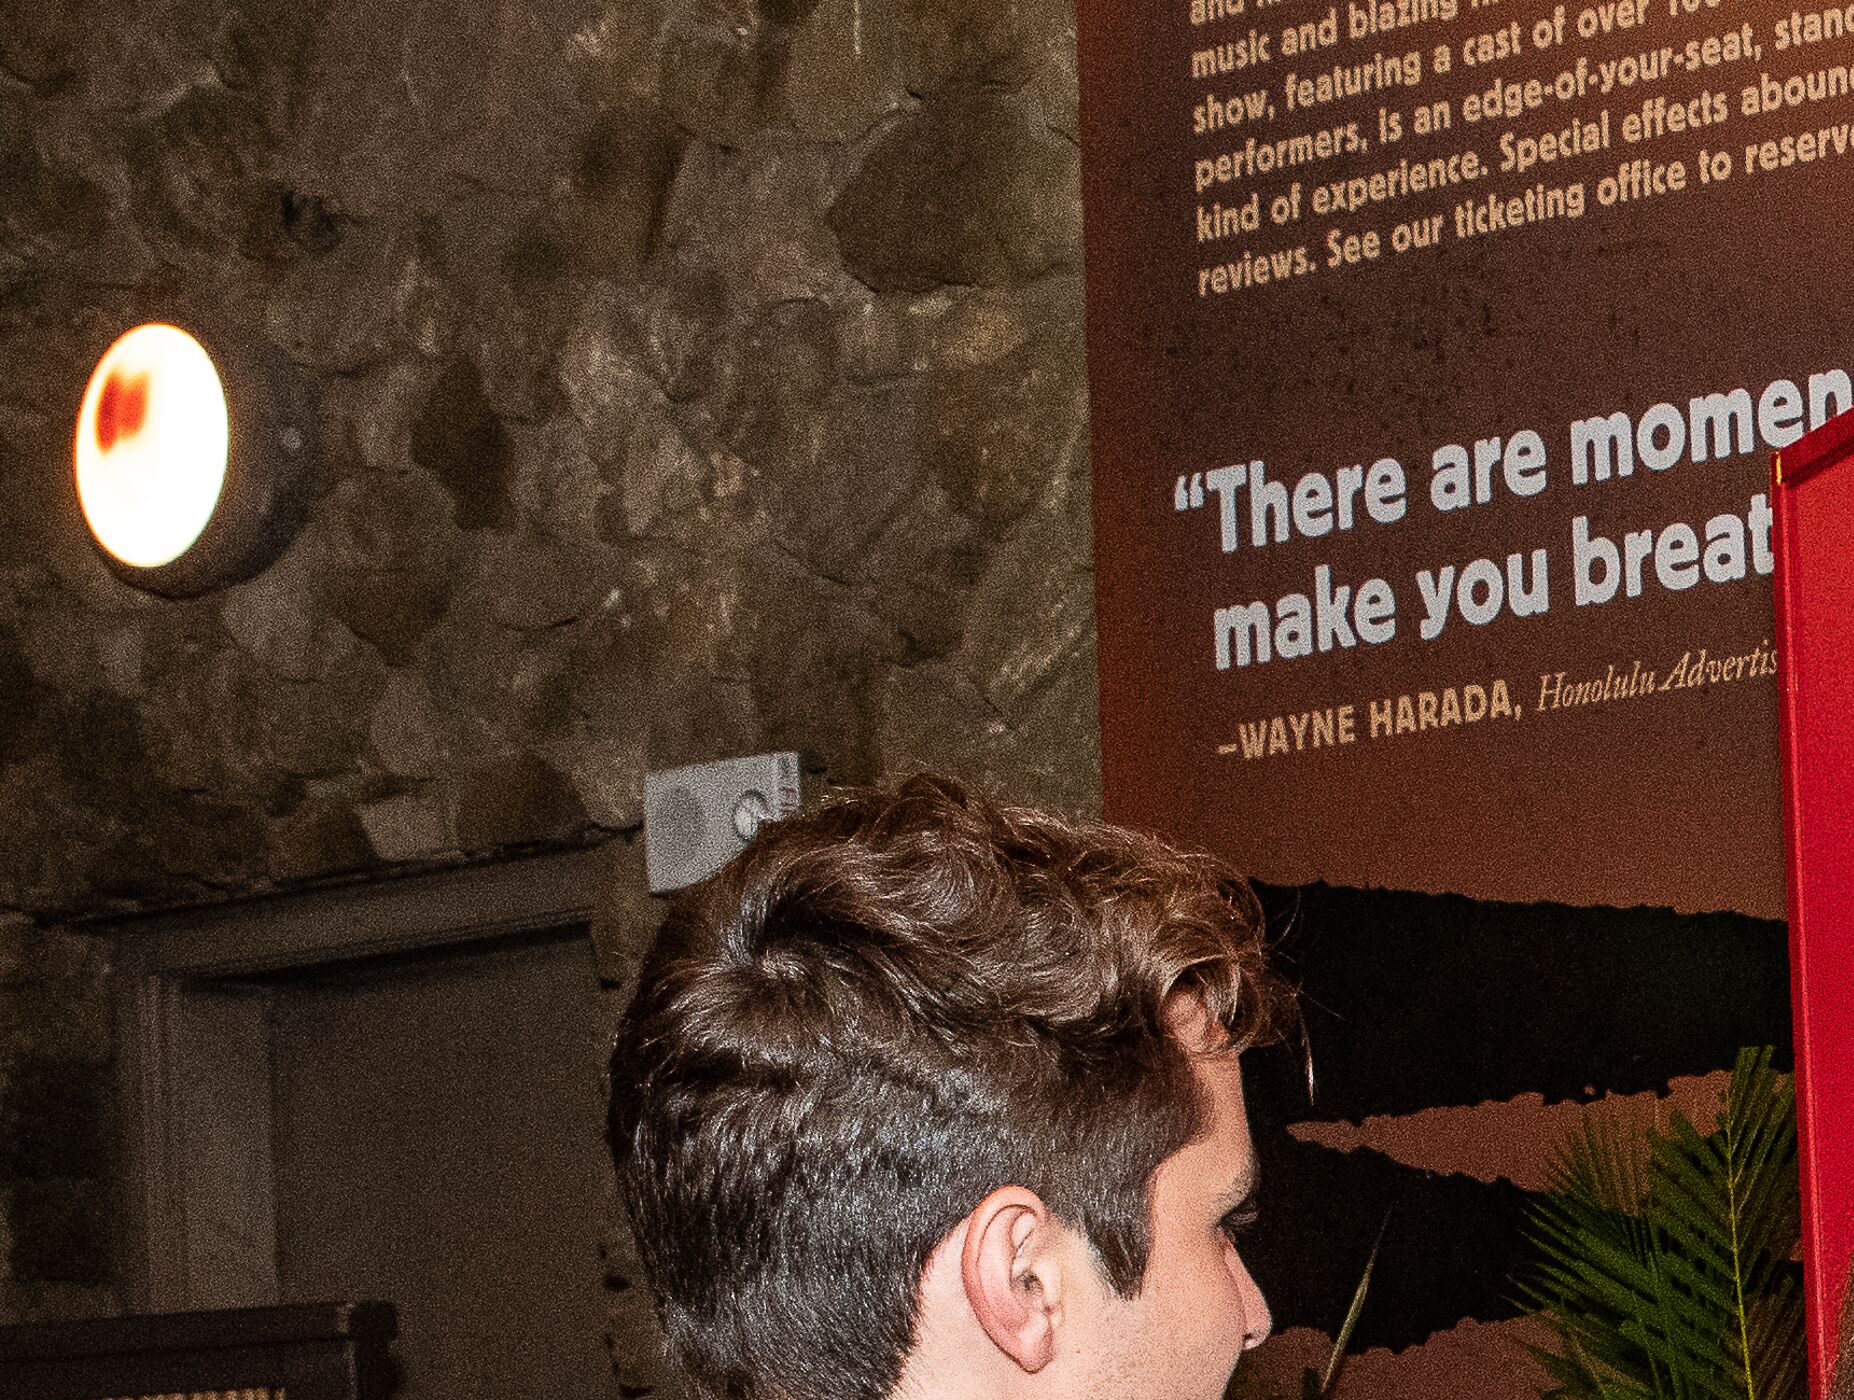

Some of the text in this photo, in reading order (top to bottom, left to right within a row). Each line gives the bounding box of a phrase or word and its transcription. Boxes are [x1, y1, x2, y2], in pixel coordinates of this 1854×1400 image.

[1195, 23, 1761, 193] performers, is an edge-of-your-seat,
[1199, 194, 1260, 243] kind
[1271, 184, 1301, 224] of
[1312, 151, 1488, 214] experience.
[1499, 109, 1610, 174] Special
[1621, 90, 1730, 144] effects
[1197, 242, 1317, 297] reviews.
[1326, 227, 1380, 269] See
[1392, 213, 1444, 253] our
[1454, 180, 1585, 240] ticketing
[1596, 155, 1686, 207] office
[1699, 149, 1732, 185] to
[1429, 427, 1548, 513] are
[1213, 563, 1397, 672] make
[1417, 547, 1549, 641] you
[1369, 678, 1523, 738] HARADA,
[1537, 662, 1656, 715] Honolulu
